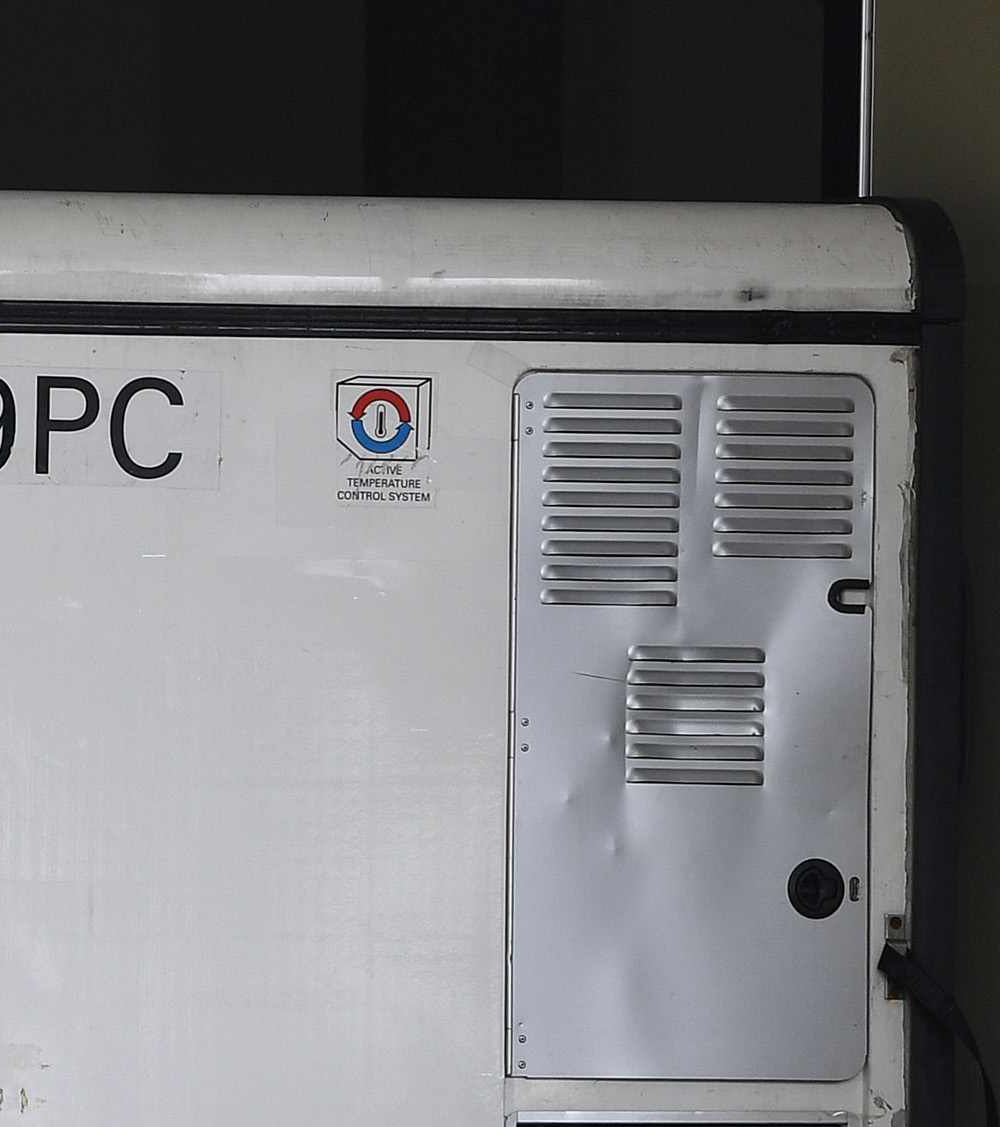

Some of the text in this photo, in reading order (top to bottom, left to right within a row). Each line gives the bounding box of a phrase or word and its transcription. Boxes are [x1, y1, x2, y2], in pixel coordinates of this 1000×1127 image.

[347, 478, 421, 488] TEMPERATURE
[337, 491, 431, 502] CONTROL SYSTEM
